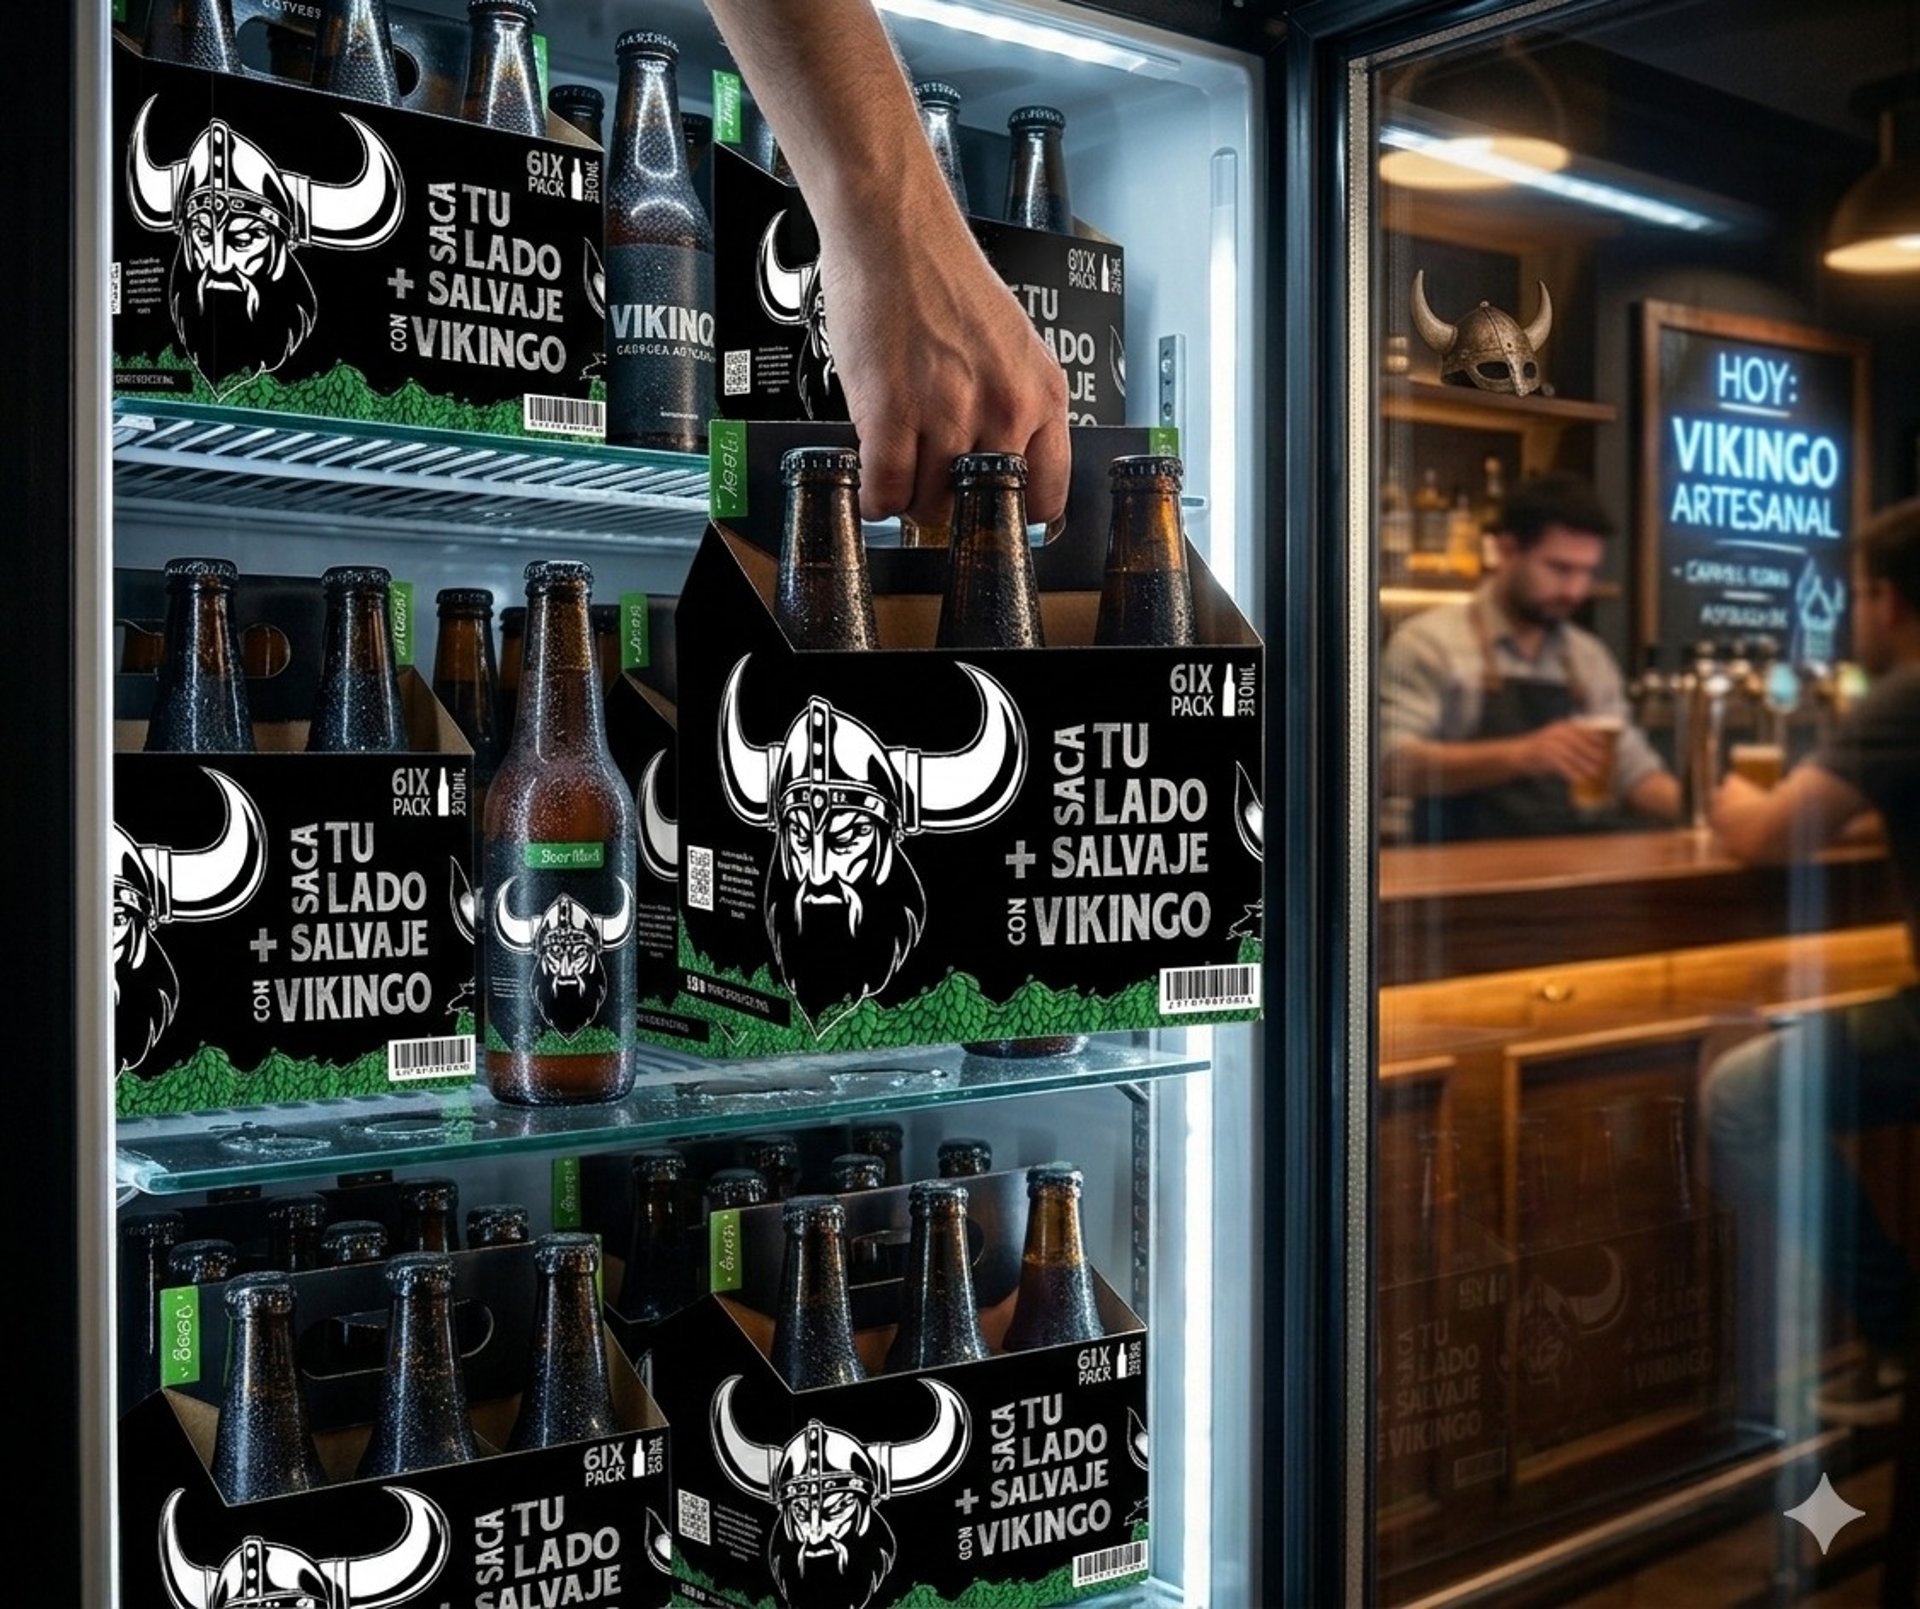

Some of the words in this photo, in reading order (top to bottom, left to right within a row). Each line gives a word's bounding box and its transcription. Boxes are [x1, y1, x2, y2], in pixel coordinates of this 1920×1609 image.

[526, 150, 563, 180] 6IX
[528, 177, 565, 198] PACK
[428, 182, 456, 264] SACA
[462, 183, 511, 227] TU
[465, 229, 561, 280] LADO
[428, 270, 563, 322] SALVAJE
[1023, 284, 1058, 320] TU
[390, 314, 407, 352] CON
[411, 316, 566, 374] VIKINGO
[1719, 352, 1797, 405] HOY:
[1672, 417, 1838, 488] VIKINGO
[1670, 482, 1841, 538] ARTESANAL
[1169, 663, 1213, 694] 6IX
[1171, 696, 1214, 716] PACK
[1093, 722, 1149, 768] TU
[392, 768, 430, 796] 6IX
[1054, 724, 1085, 826] SACA
[393, 797, 431, 816] PACK
[1094, 778, 1208, 825] LADO
[324, 821, 374, 863] TU
[1052, 832, 1209, 878] SALVAJE
[291, 823, 319, 914] SACA
[327, 871, 427, 914] LADO
[291, 920, 429, 962] SALVAJE
[1007, 898, 1026, 946] CON
[1032, 891, 1211, 946] VIKINGO
[274, 972, 432, 1022] VIKINGO
[1020, 1392, 1063, 1429] TU
[583, 1442, 625, 1470] 6IX
[991, 1402, 1015, 1474] SACA
[1022, 1423, 1108, 1468] LADO
[585, 1466, 626, 1487] PACK
[990, 1458, 1109, 1509] SALVAJE
[511, 1495, 565, 1537] TU
[977, 1498, 1111, 1557] VIKINGO
[475, 1508, 505, 1586] SACA
[514, 1526, 620, 1578] LADO
[475, 1564, 621, 1609] SALVAJE
